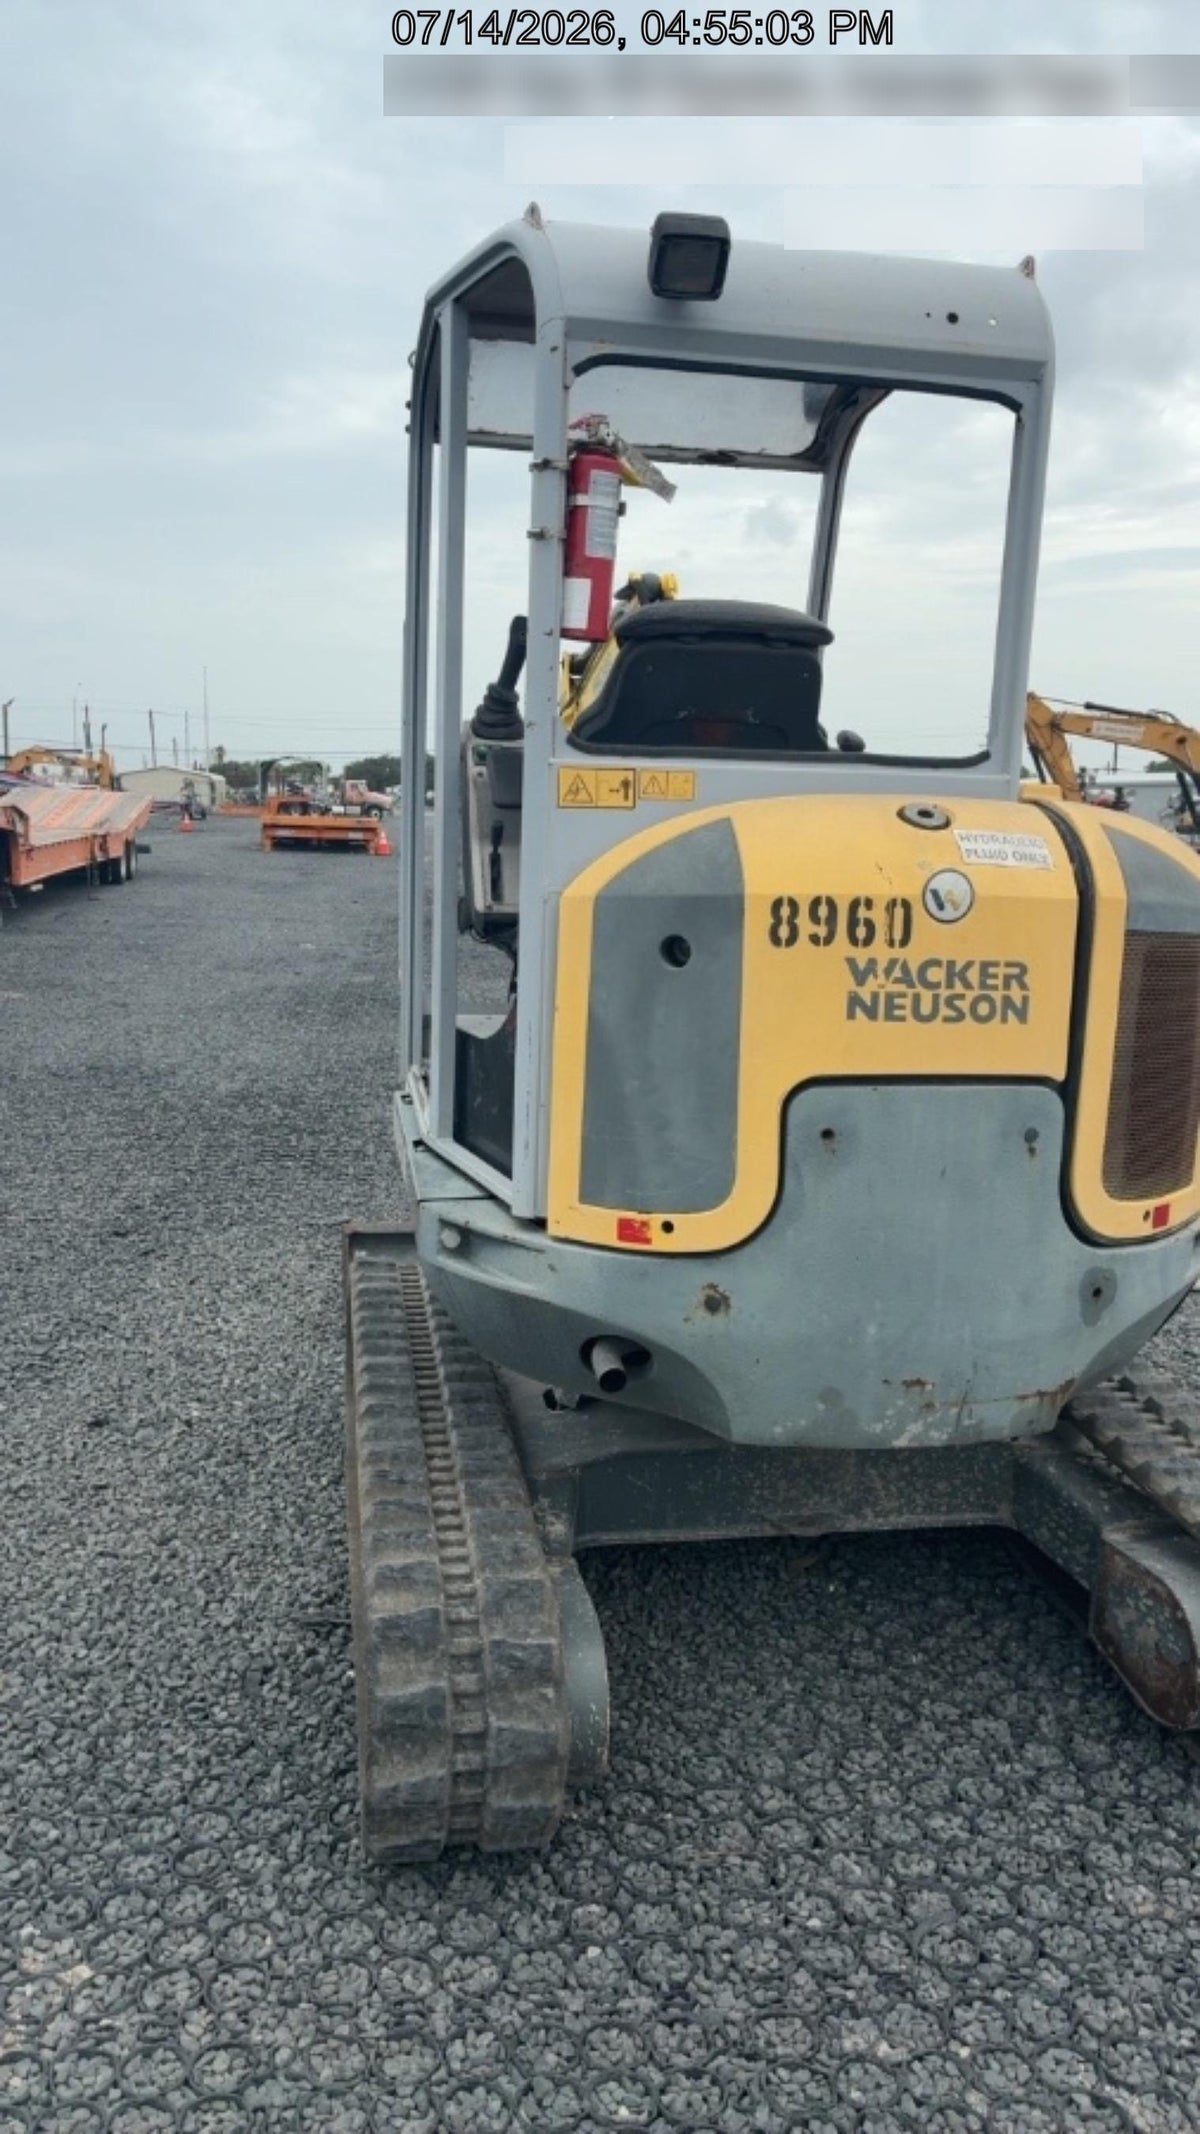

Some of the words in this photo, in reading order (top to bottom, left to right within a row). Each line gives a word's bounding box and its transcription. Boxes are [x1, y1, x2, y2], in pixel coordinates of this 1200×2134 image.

[768, 895, 913, 948] 8960
[845, 957, 1029, 991] WACKER
[846, 991, 1029, 1024] NEUSON
